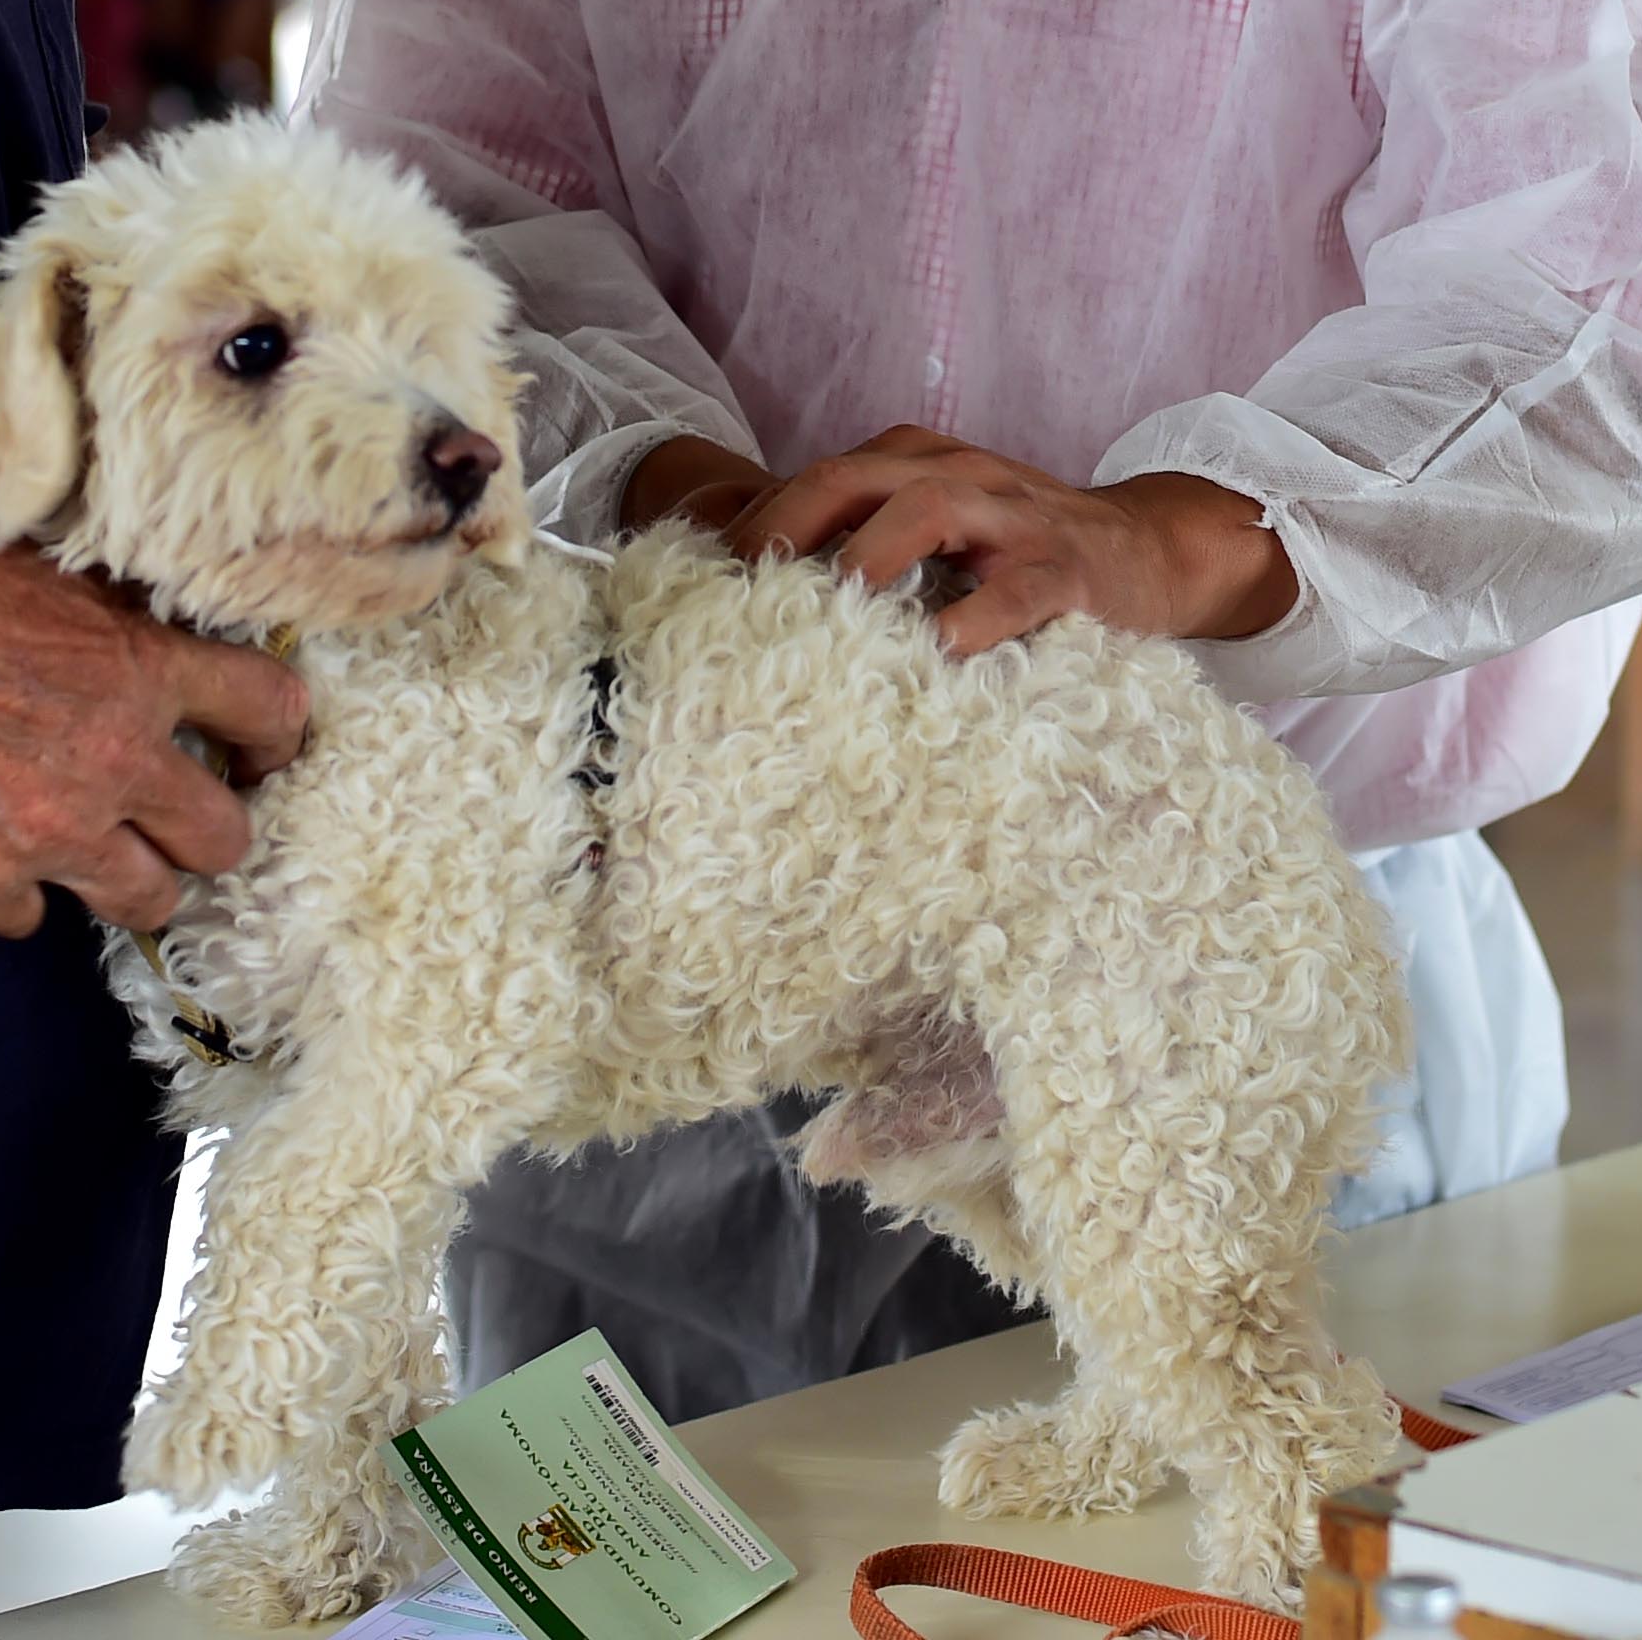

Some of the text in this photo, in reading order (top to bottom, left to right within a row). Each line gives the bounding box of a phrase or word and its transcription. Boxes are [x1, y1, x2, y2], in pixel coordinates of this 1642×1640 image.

[407, 1447, 464, 1513] ESPAÑA
[601, 1437, 637, 1477] GATOS
[558, 1459, 650, 1559] ANDALUCÍA
[566, 1438, 675, 1561] CARTILLA SANITARIA
[623, 1476, 651, 1505] PARA
[644, 1490, 688, 1534] PERROS
[460, 1518, 487, 1544] DE
[496, 1408, 683, 1625] COMUNIDAD AUTÓNOMA
[580, 1504, 606, 1528] DE
[484, 1548, 538, 1603] REINO
